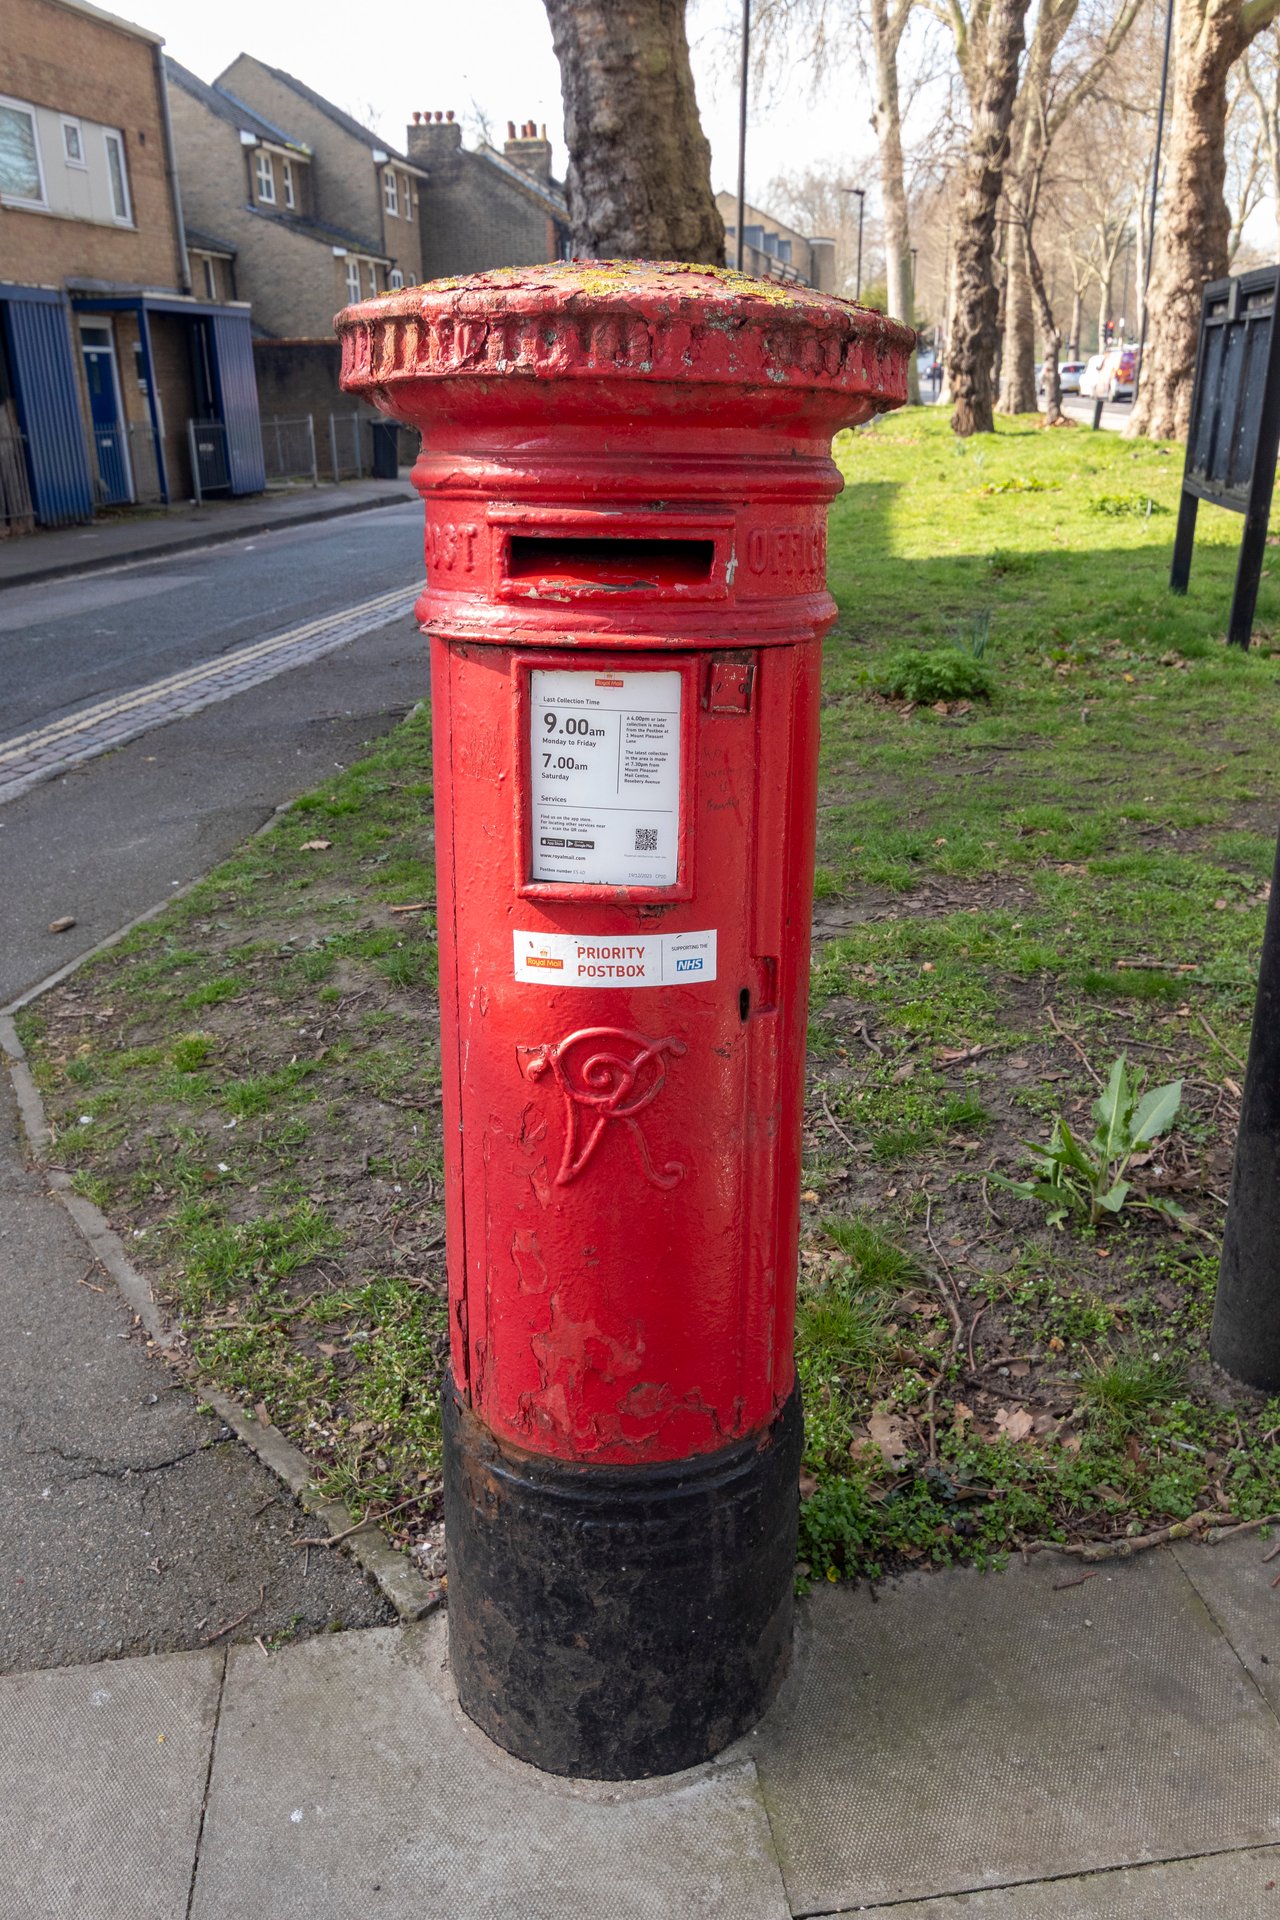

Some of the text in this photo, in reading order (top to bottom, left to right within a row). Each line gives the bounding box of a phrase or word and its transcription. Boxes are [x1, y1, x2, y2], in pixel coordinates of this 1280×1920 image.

[544, 712, 605, 736] 9.00am
[542, 753, 588, 770] 7.00am
[542, 772, 569, 781] Saturday
[578, 947, 645, 959] PRIORITY
[528, 958, 545, 966] Royal
[677, 959, 701, 970] NHS
[578, 964, 645, 977] POSTBOX
